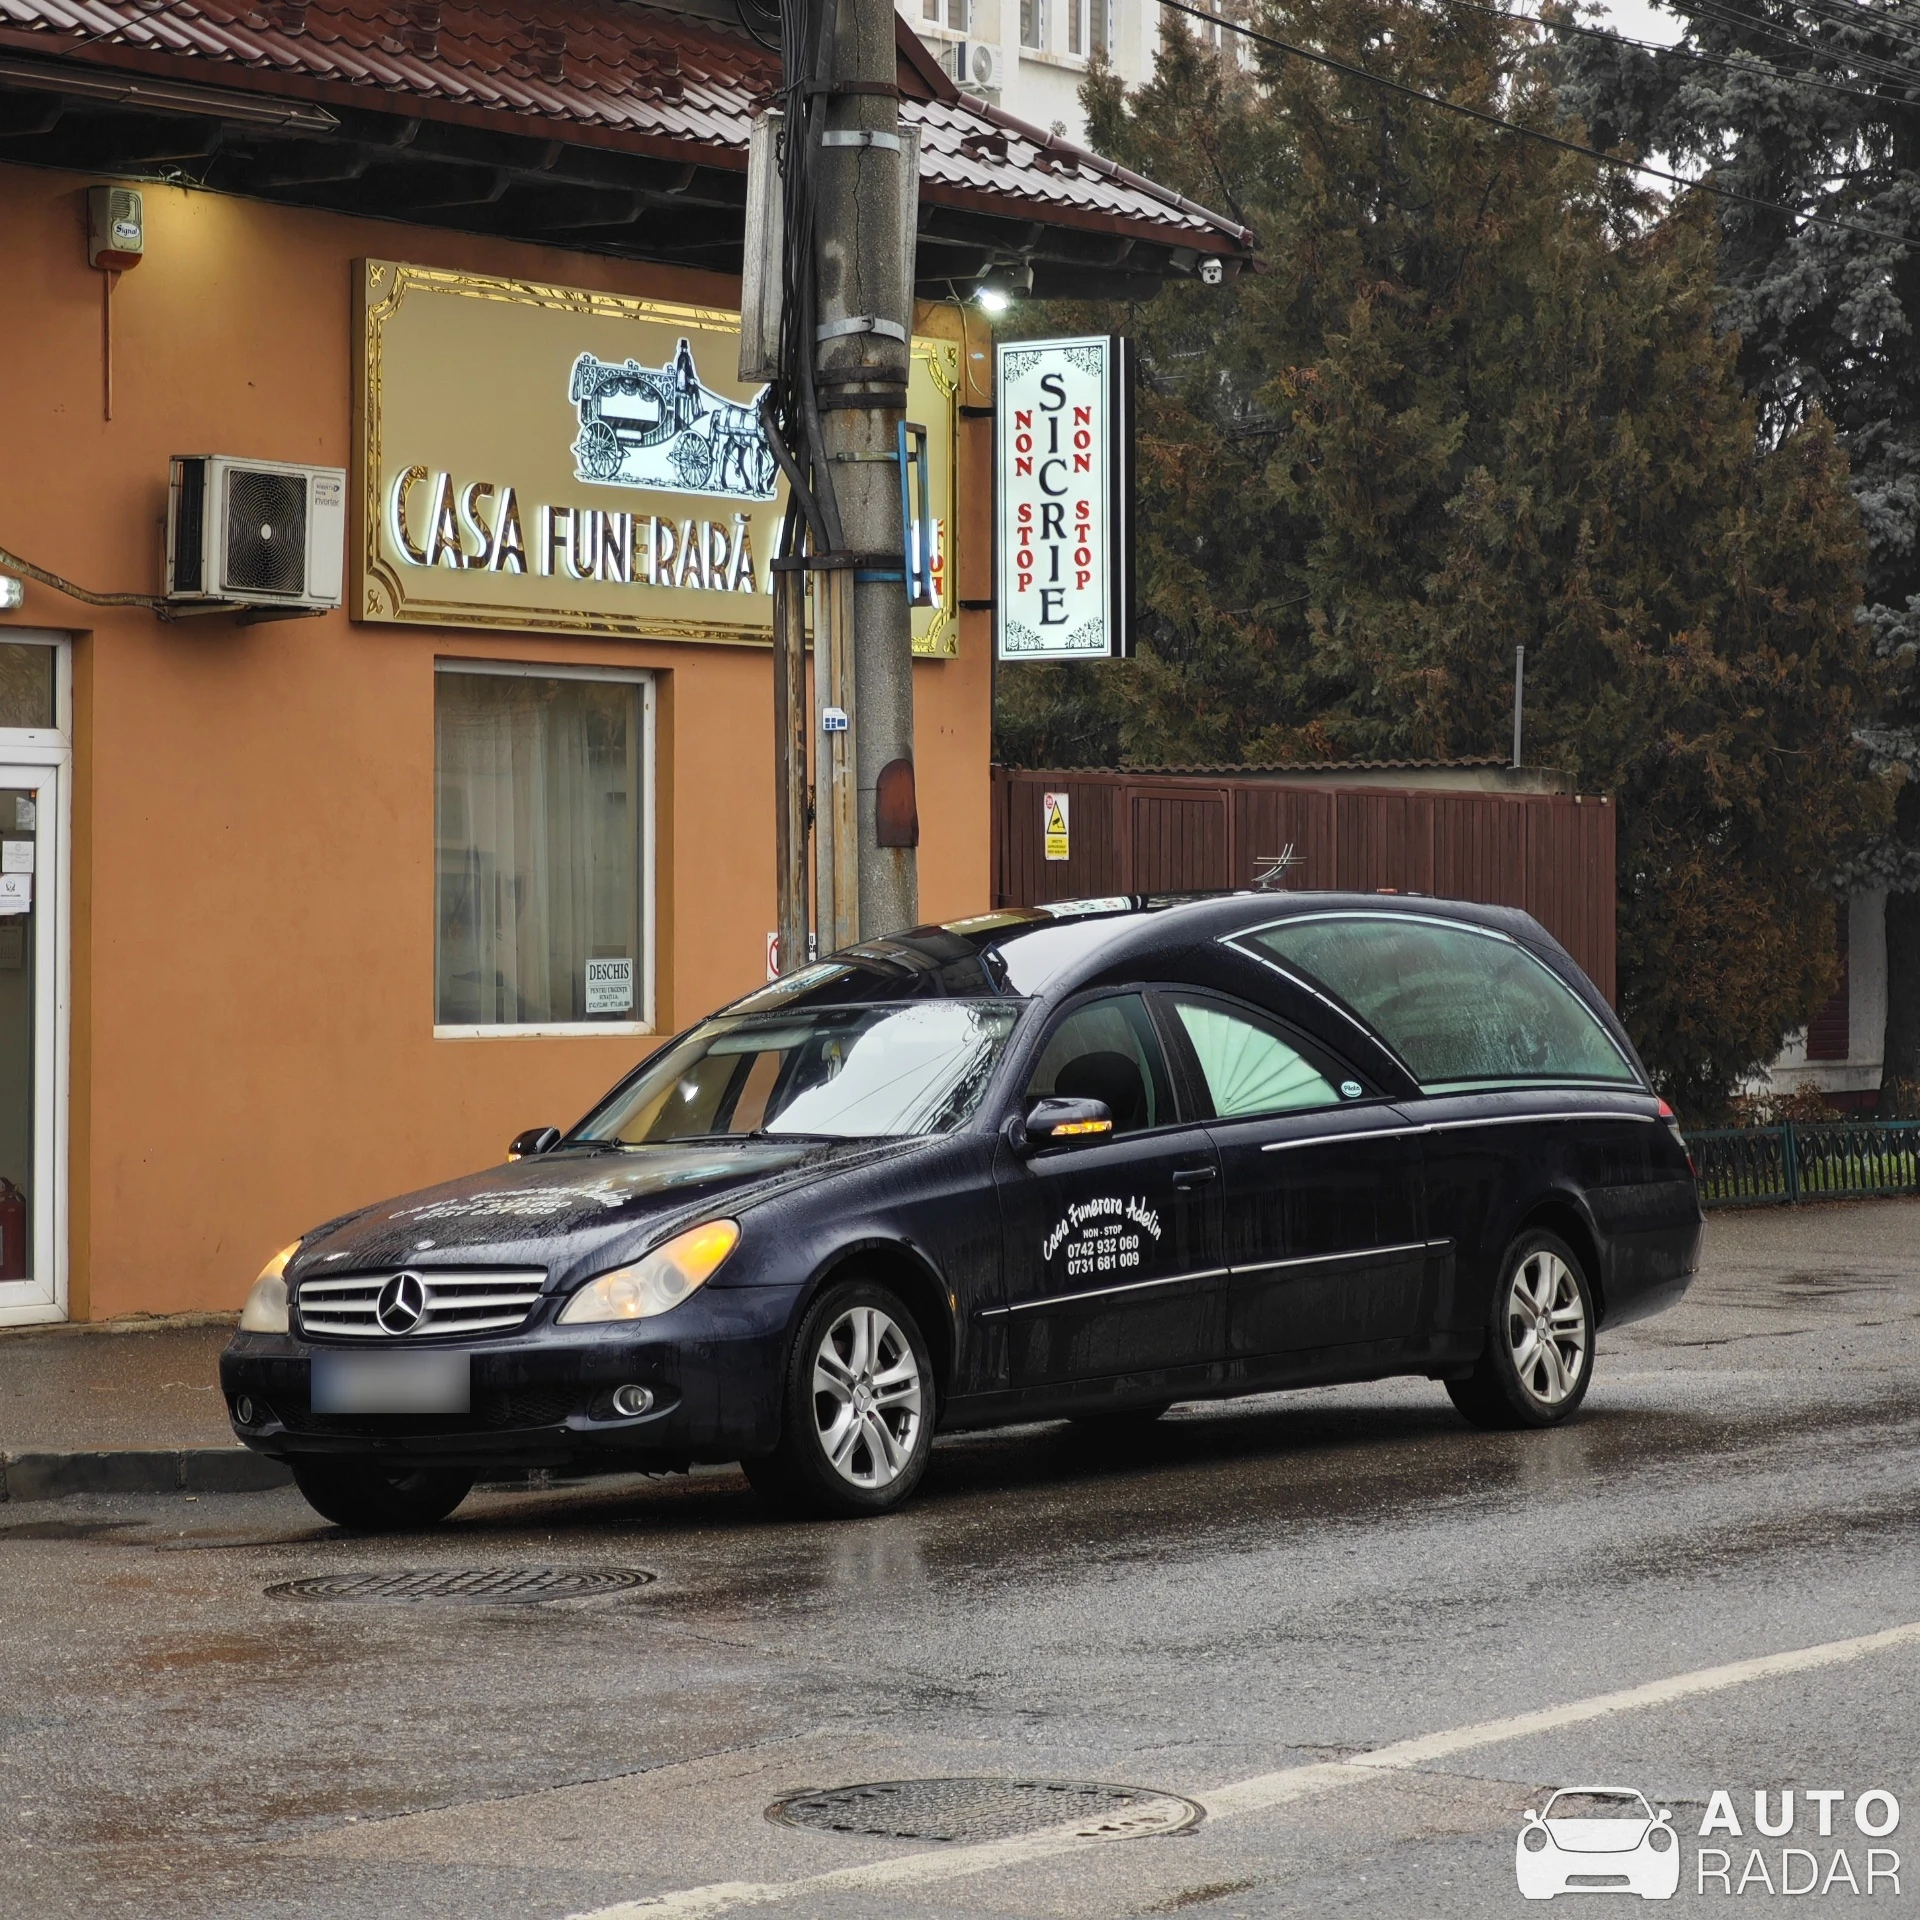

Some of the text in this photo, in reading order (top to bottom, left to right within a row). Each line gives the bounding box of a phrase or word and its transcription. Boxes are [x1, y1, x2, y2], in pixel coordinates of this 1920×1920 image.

[116, 225, 138, 236] Signal
[1015, 409, 1033, 592] NON STOP
[1039, 373, 1069, 625] SICRIE
[1073, 406, 1092, 590] NON STOP
[391, 464, 528, 574] CASA
[541, 505, 757, 594] FUNERARĂ
[589, 963, 629, 980] DESCHIS
[514, 1207, 557, 1215] 009
[1043, 1195, 1162, 1261] Casa Funerara Adelin
[1067, 1234, 1139, 1258] 0742 932 060
[1068, 1251, 1140, 1275] 0731 681 009
